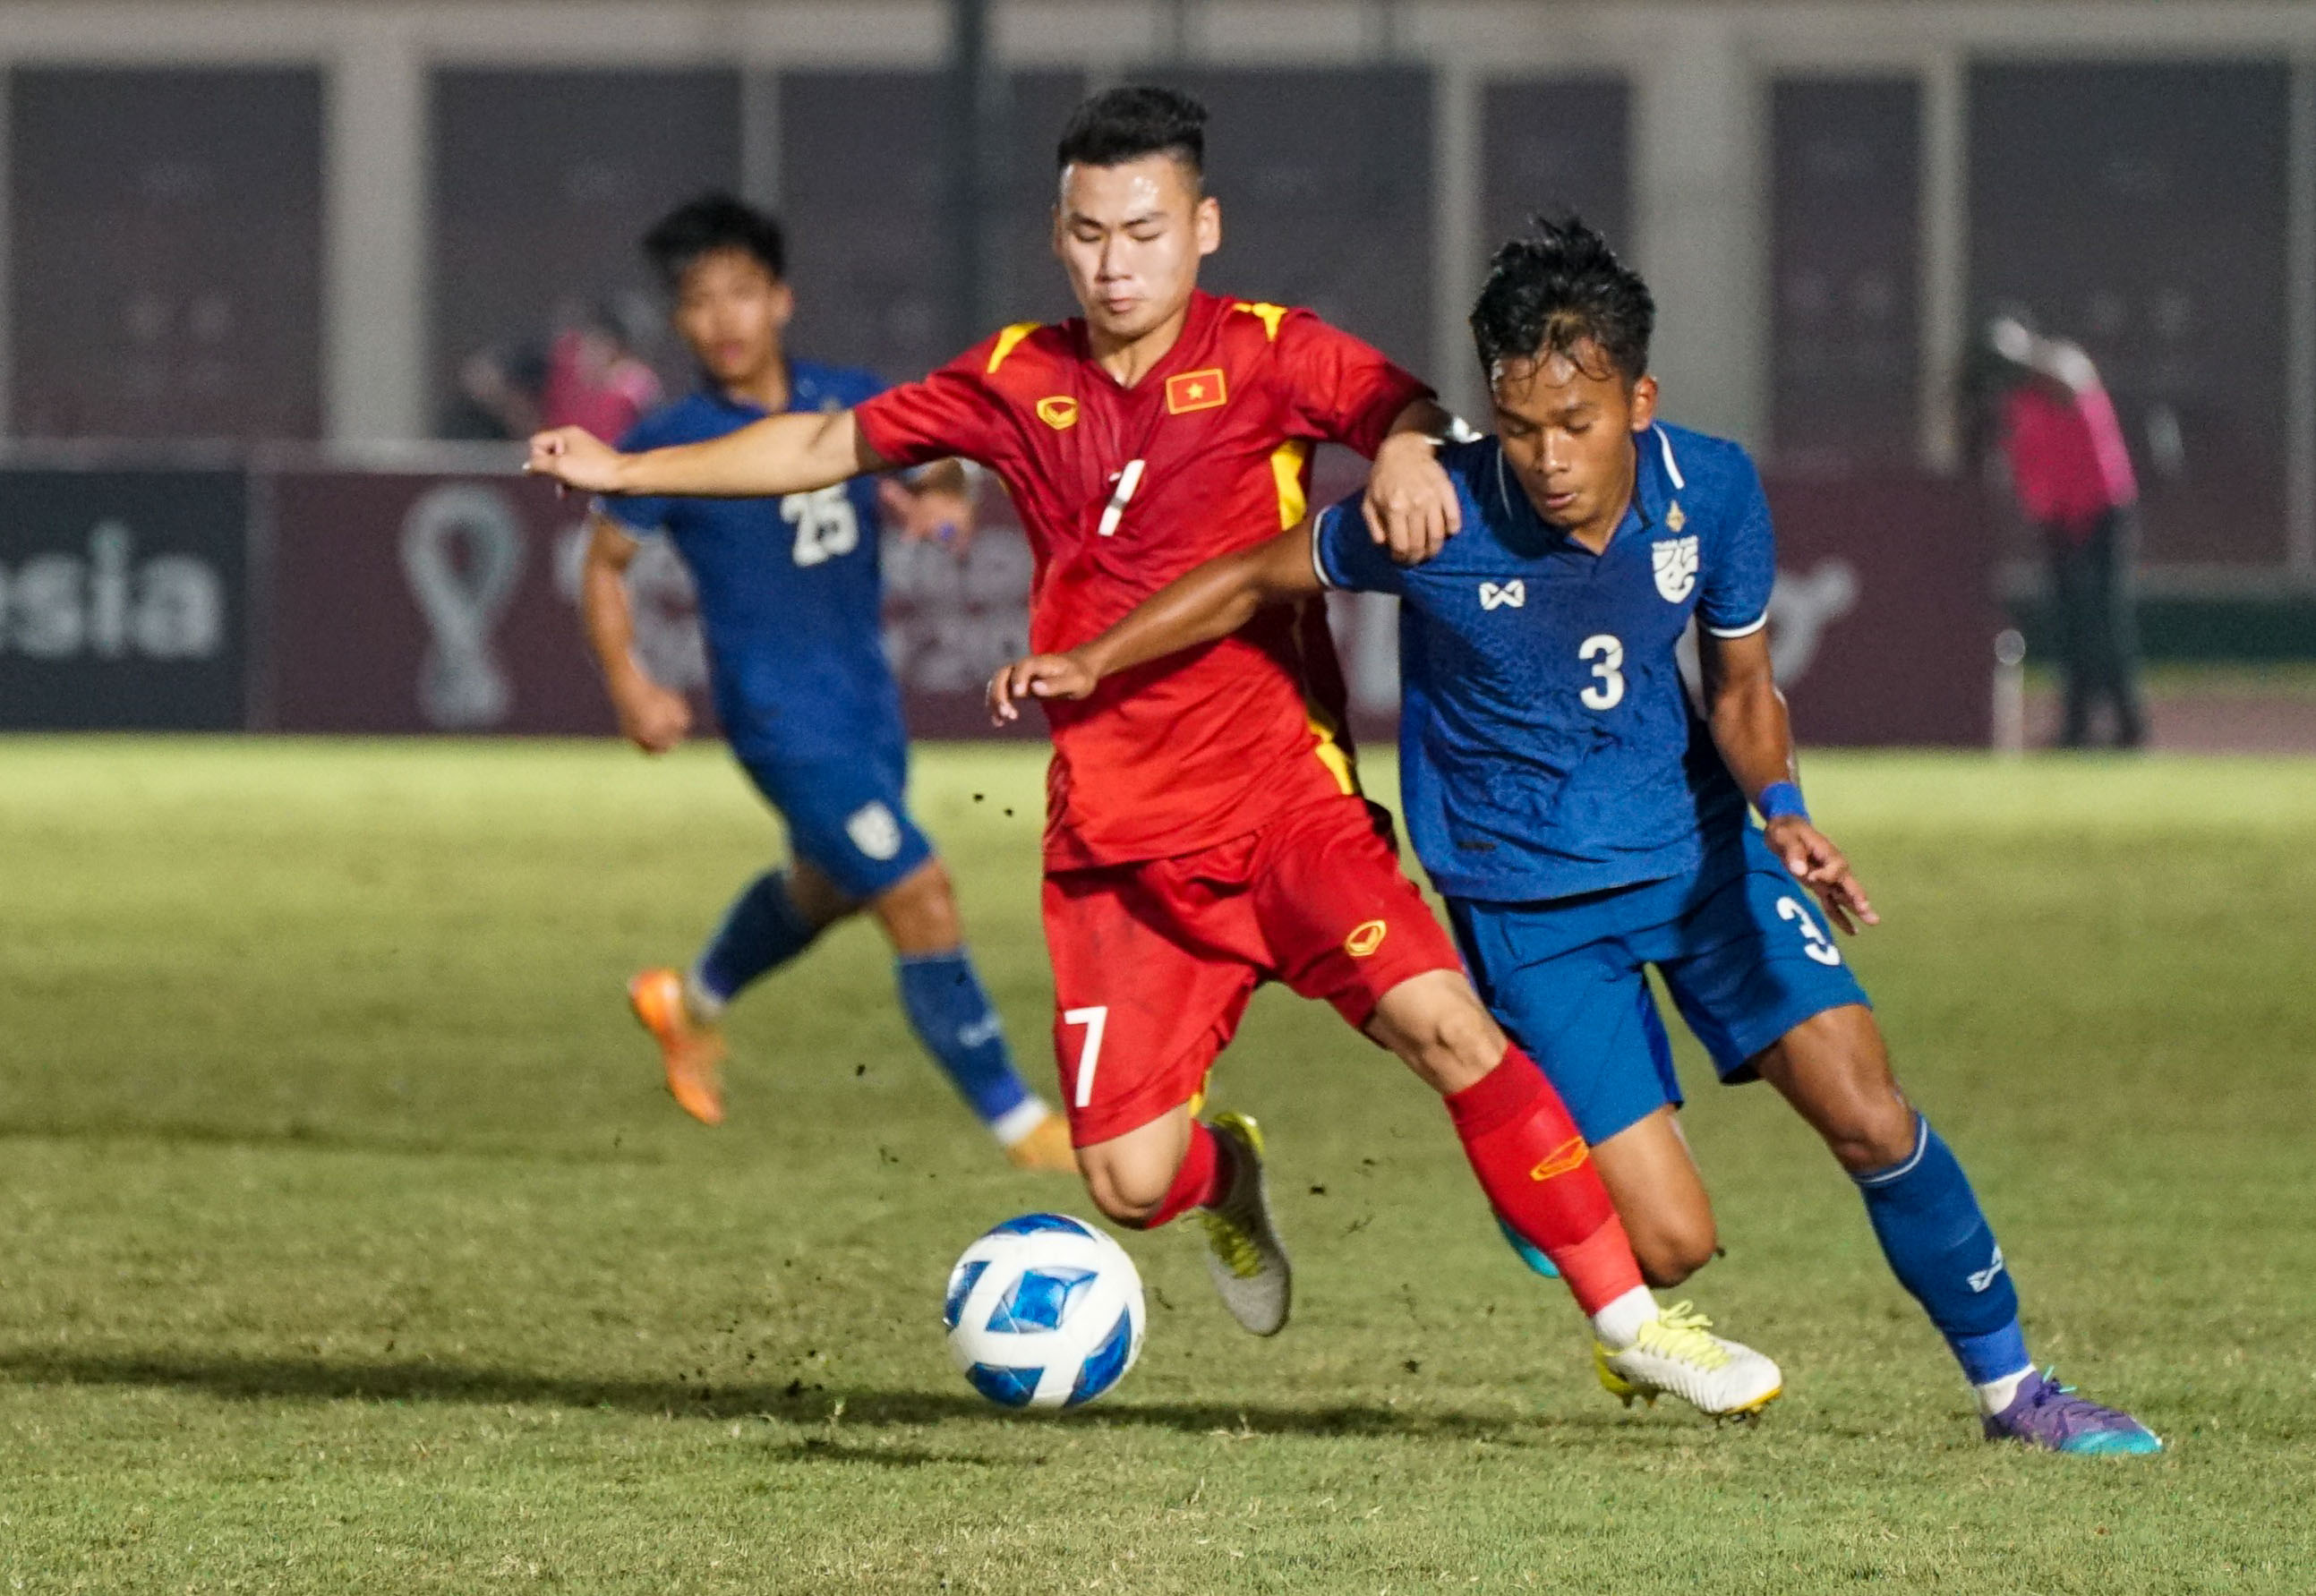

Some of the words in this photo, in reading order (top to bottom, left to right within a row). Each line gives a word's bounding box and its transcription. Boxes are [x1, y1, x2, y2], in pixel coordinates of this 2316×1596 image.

[780, 482, 859, 567] 25
[1578, 634, 1624, 710] 3
[1776, 896, 1841, 966] 3
[1064, 1005, 1107, 1107] 7
